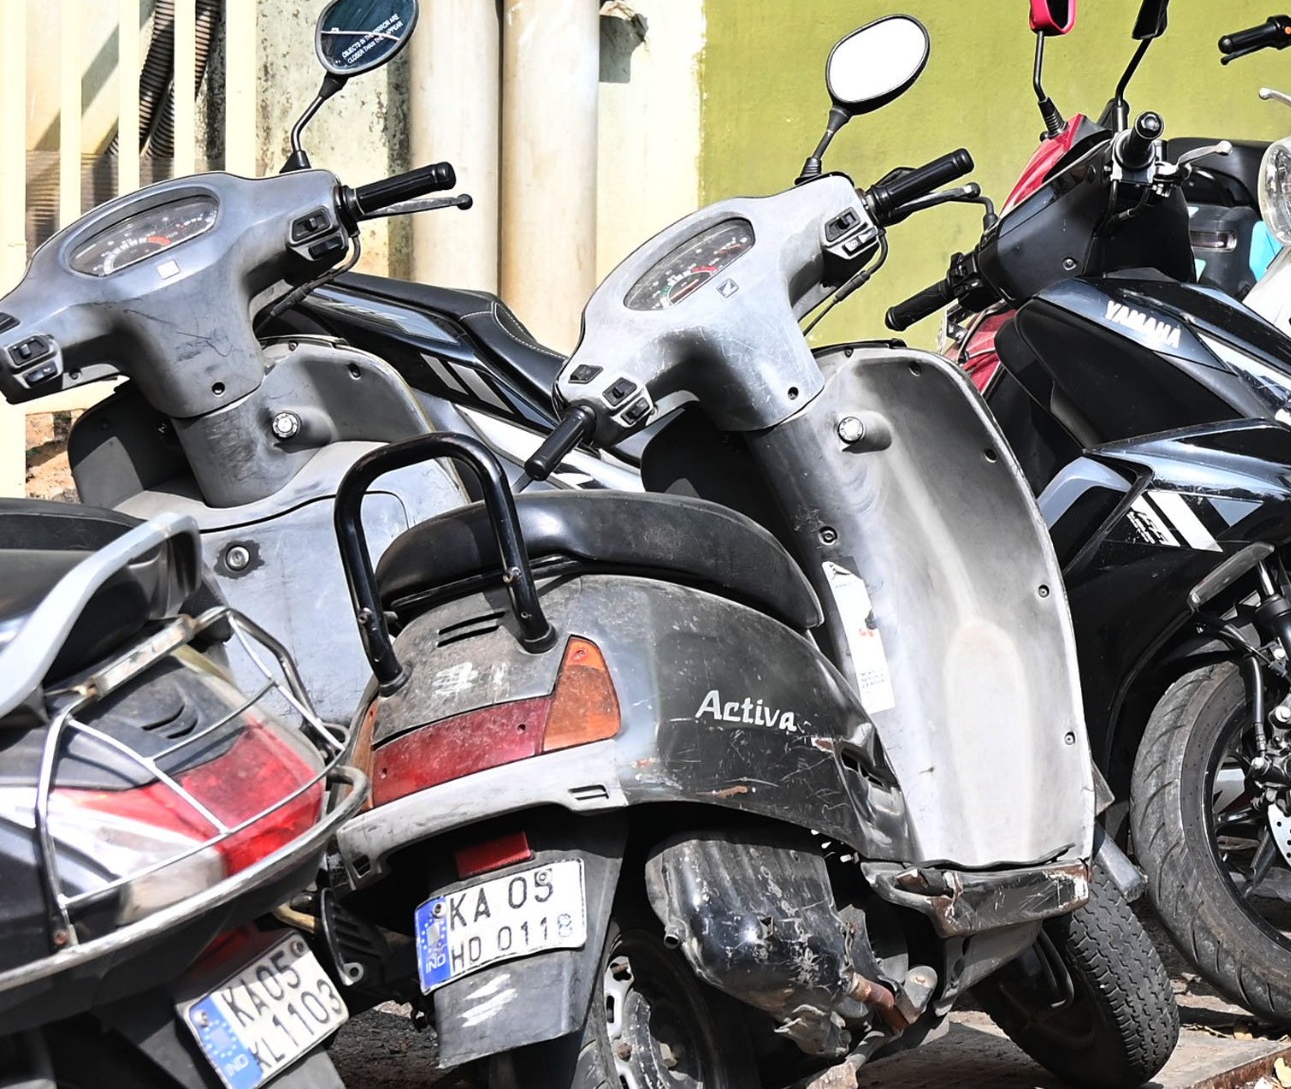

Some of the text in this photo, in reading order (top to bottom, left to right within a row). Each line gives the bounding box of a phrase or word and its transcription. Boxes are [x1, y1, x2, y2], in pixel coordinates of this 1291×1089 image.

[1105, 300, 1181, 349] YAMAHA
[694, 689, 798, 733] Activa
[448, 867, 555, 932] KA 05
